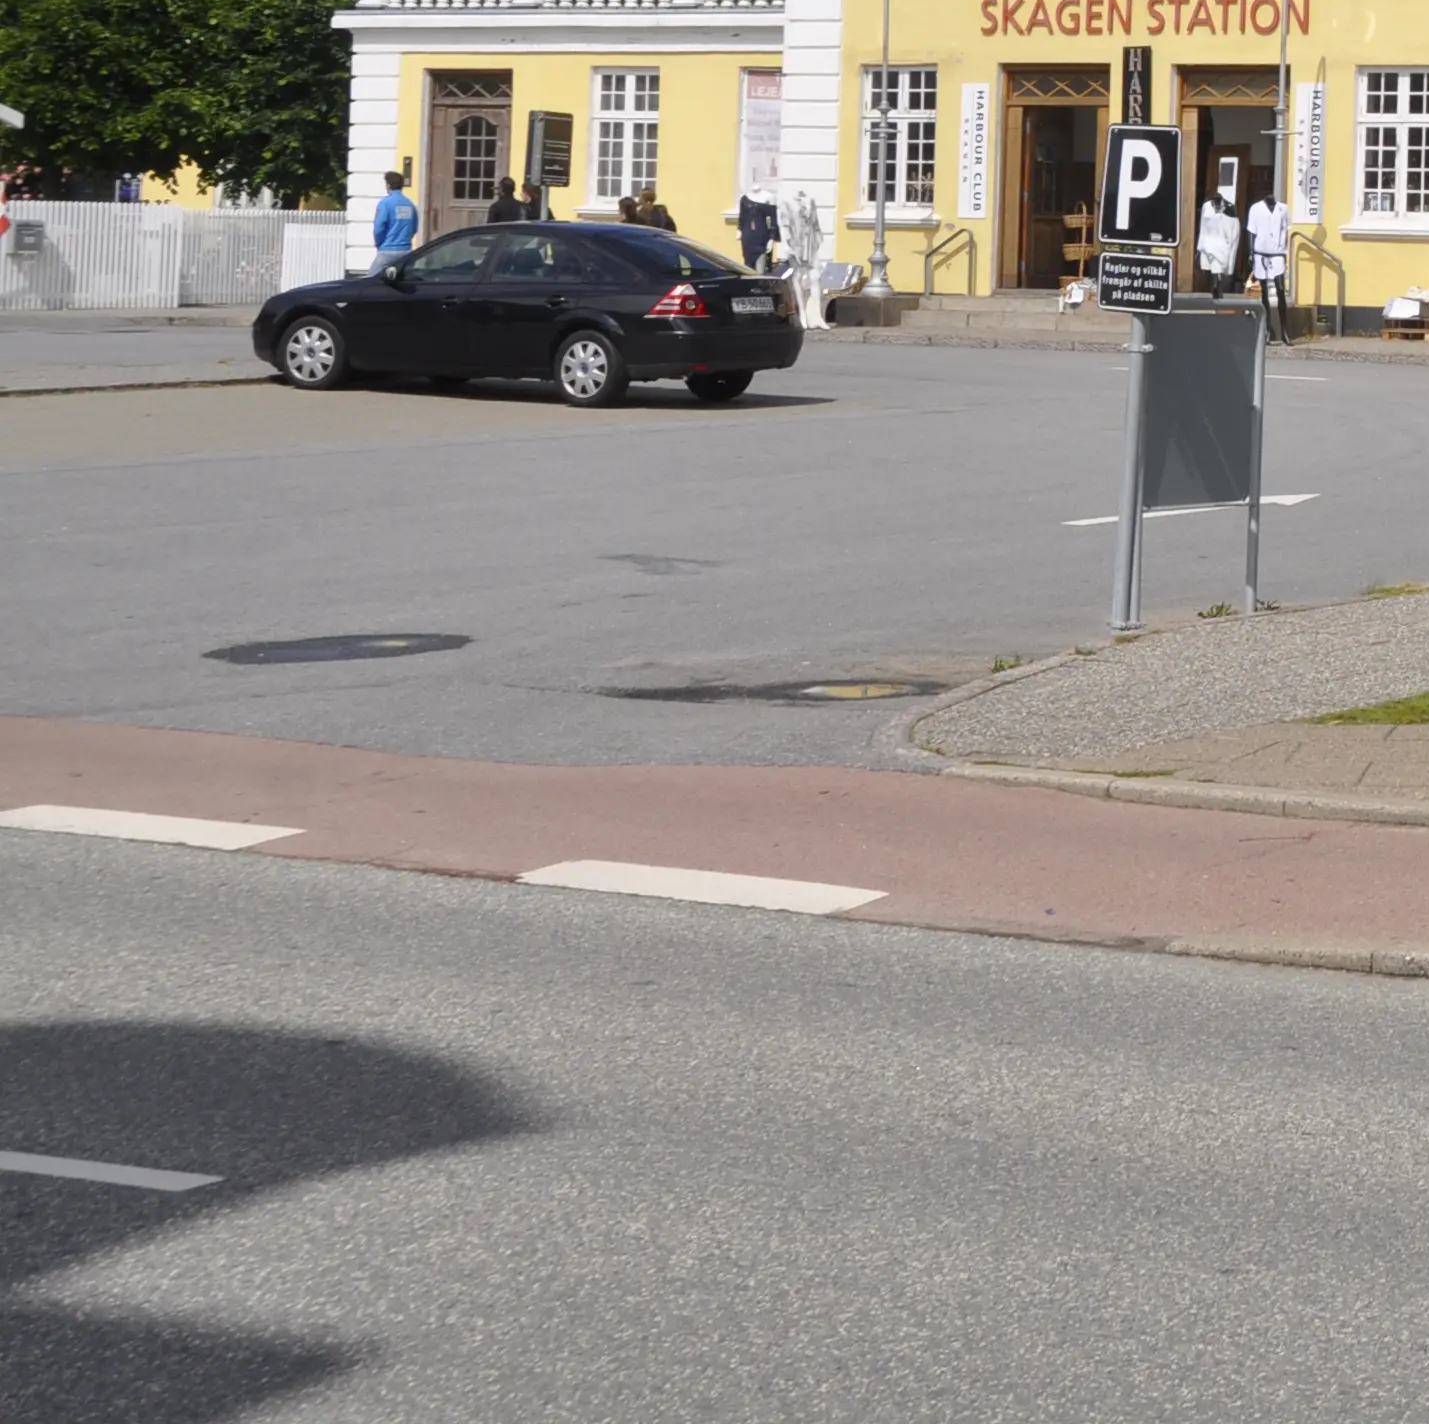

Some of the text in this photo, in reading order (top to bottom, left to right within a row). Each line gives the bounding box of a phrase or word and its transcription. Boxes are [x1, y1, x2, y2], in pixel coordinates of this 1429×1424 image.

[973, 90, 985, 212] HARBOUR CLUB
[1308, 90, 1322, 216] HARBOUR CLUB
[1115, 138, 1162, 231] P
[1102, 275, 1132, 288] fremgår
[1133, 277, 1142, 287] af
[1104, 262, 1167, 276] Regler og vilkår
[1112, 289, 1155, 302] på pladsen
